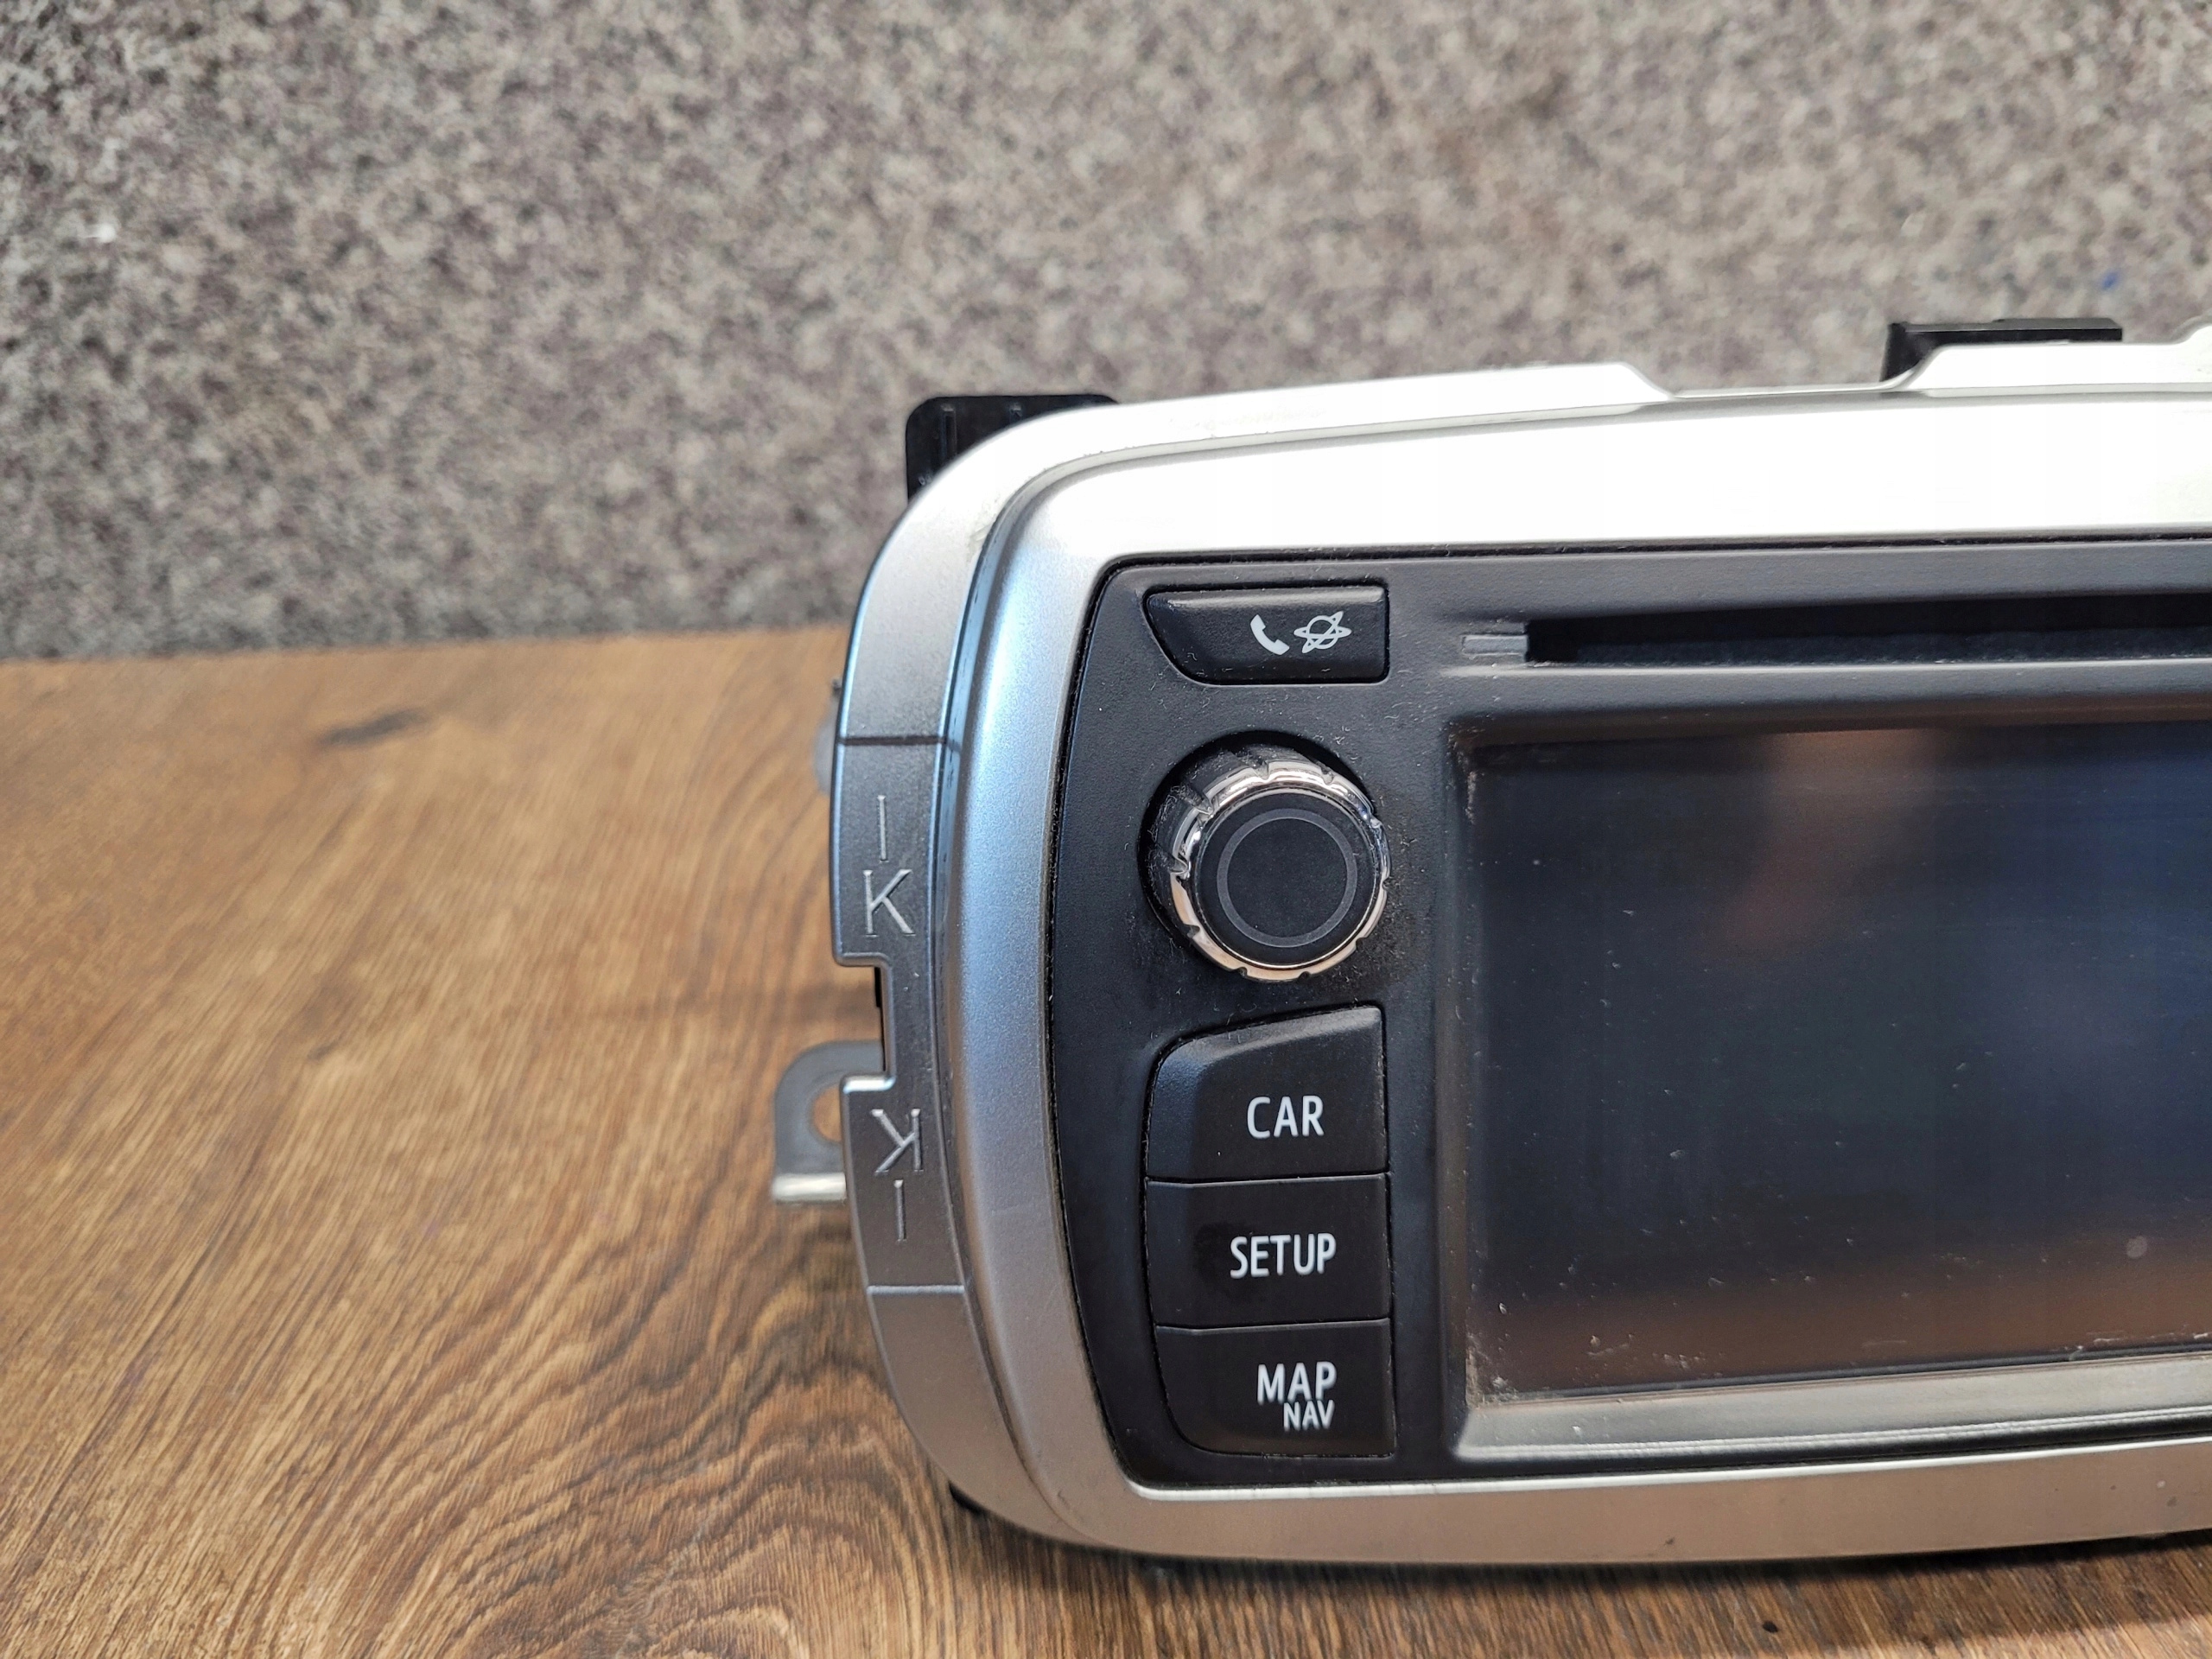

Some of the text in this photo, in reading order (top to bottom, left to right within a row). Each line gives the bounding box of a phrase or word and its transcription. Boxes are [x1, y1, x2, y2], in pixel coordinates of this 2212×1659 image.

[1247, 1095, 1325, 1139] CAR
[1230, 1232, 1337, 1279] SETUP
[1257, 1361, 1337, 1405] MAP
[1282, 1401, 1336, 1432] NAV
